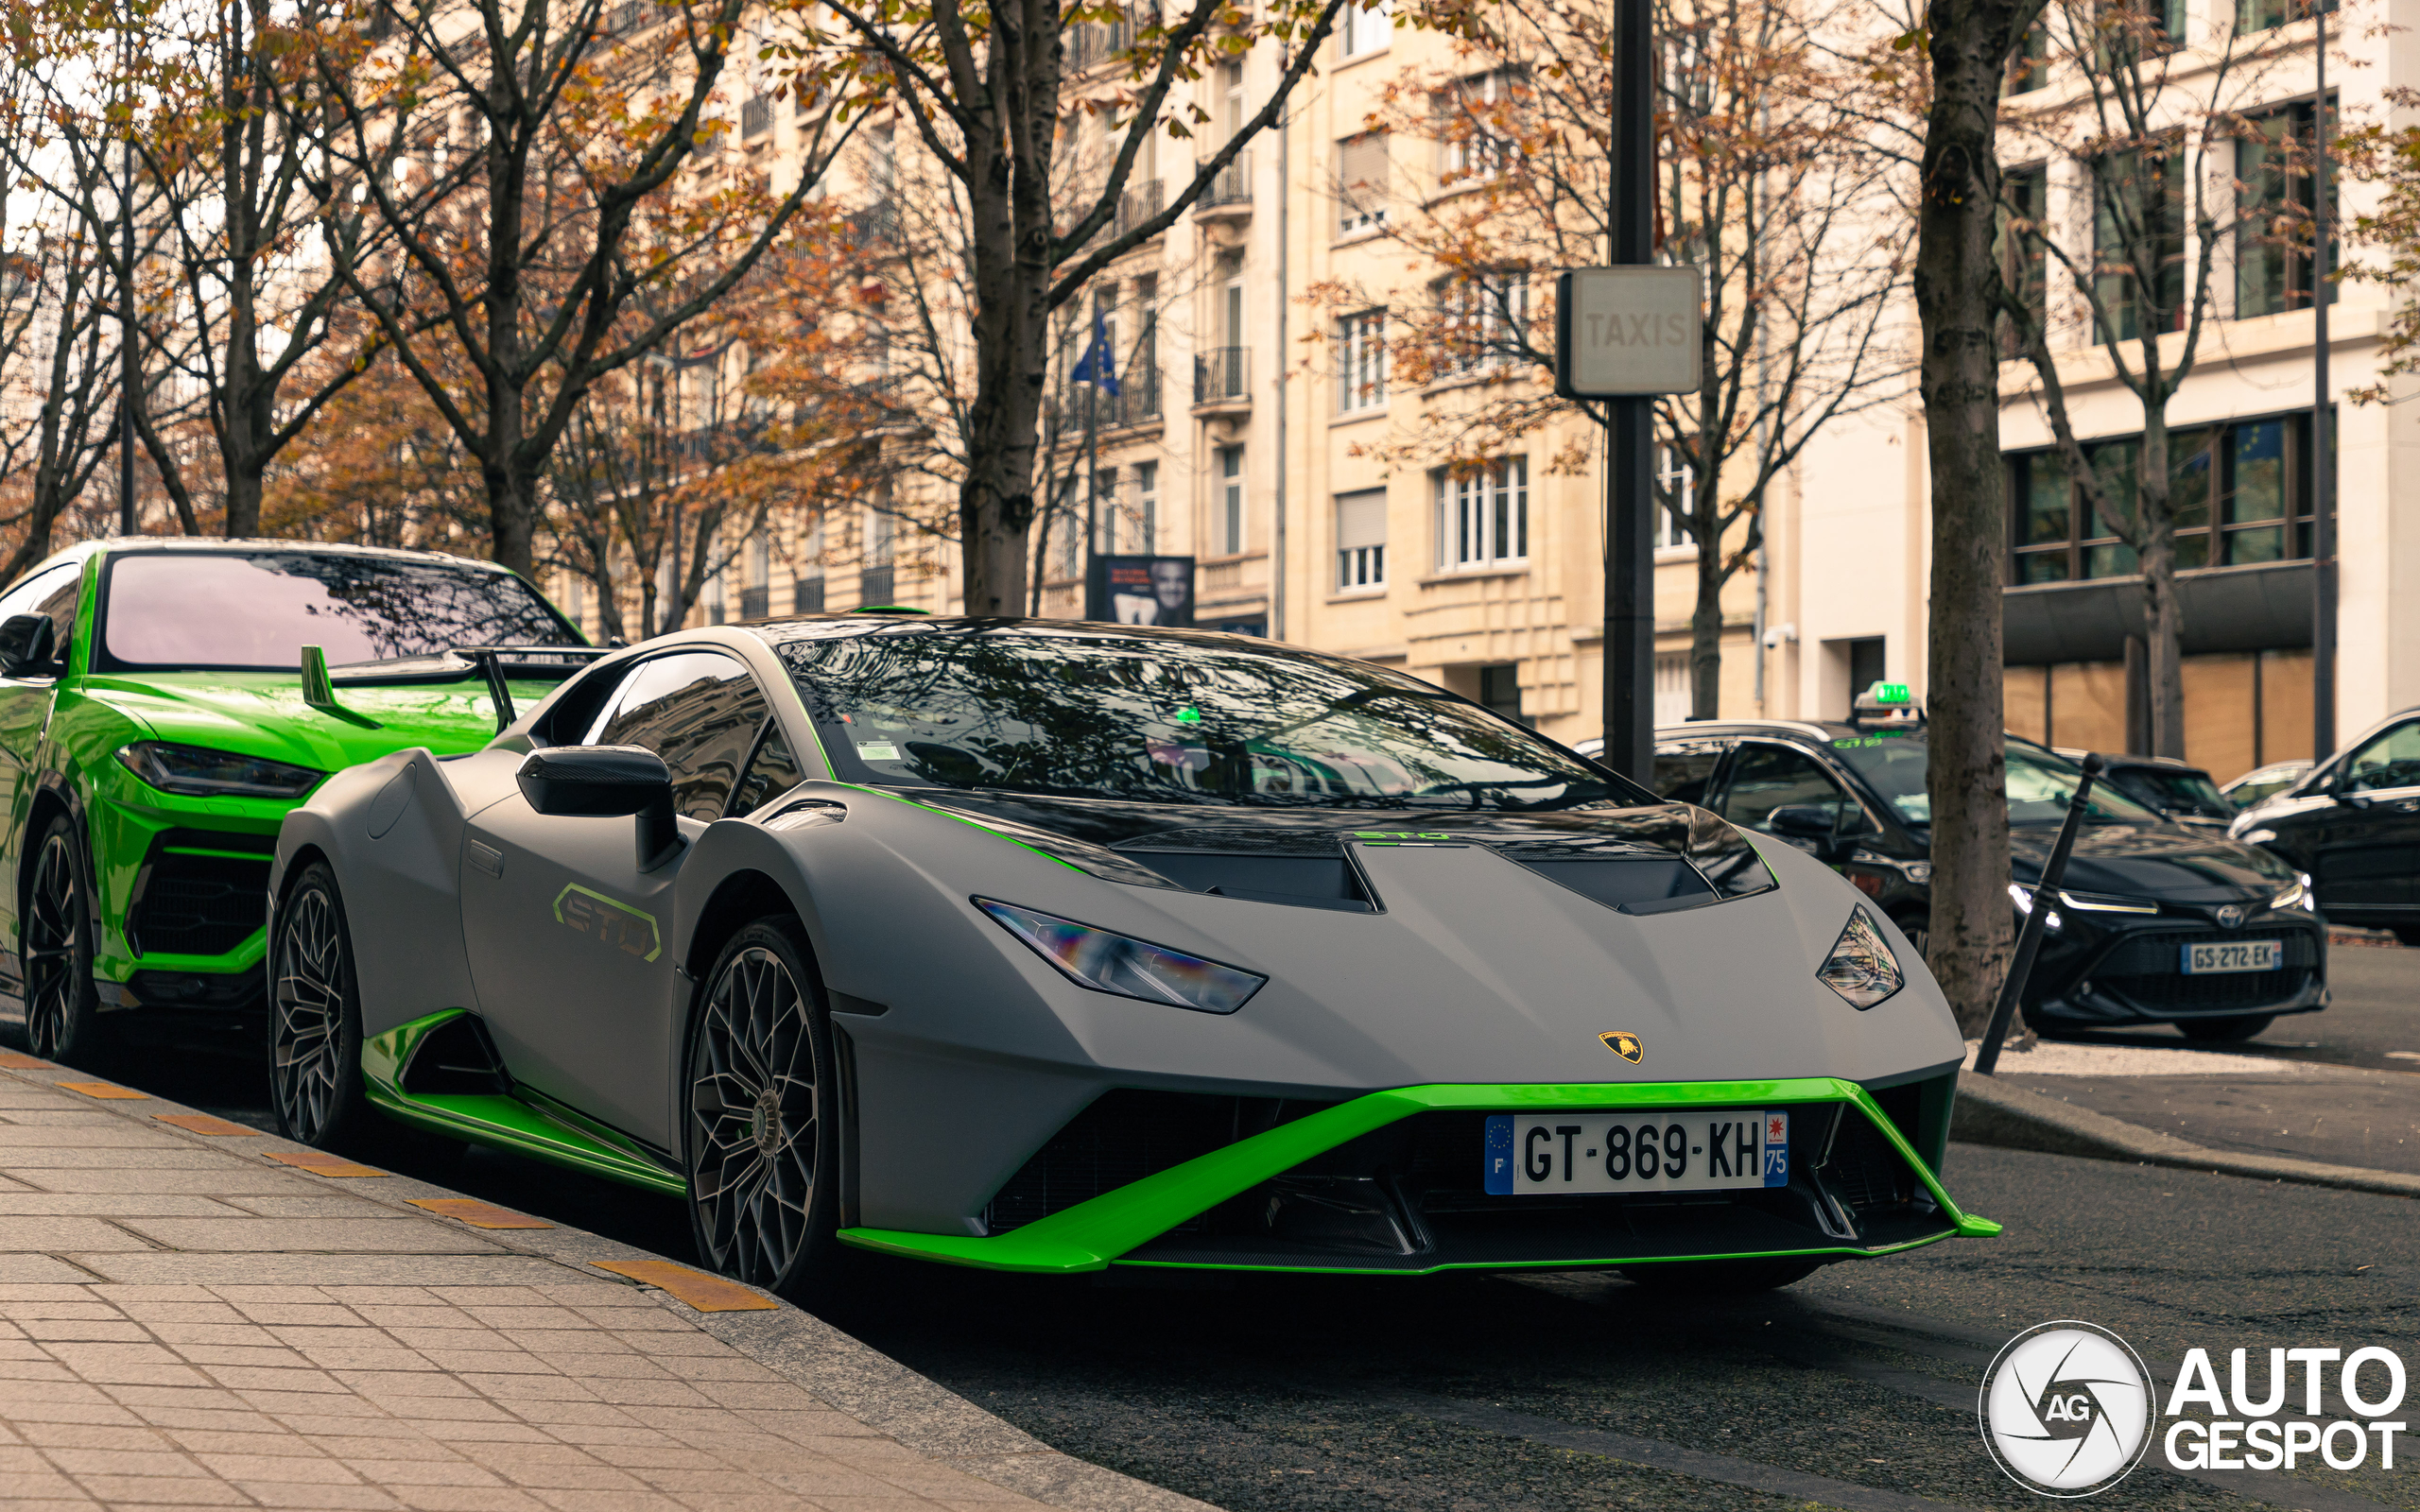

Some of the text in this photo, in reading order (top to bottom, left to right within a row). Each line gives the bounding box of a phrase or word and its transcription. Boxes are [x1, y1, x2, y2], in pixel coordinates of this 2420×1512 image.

[1586, 313, 1686, 347] TAXIS
[1353, 831, 1450, 840] STO
[565, 896, 649, 956] STO
[1495, 1158, 1504, 1174] F
[1525, 1122, 1758, 1182] GT-869-KH
[1766, 1149, 1787, 1175] 75
